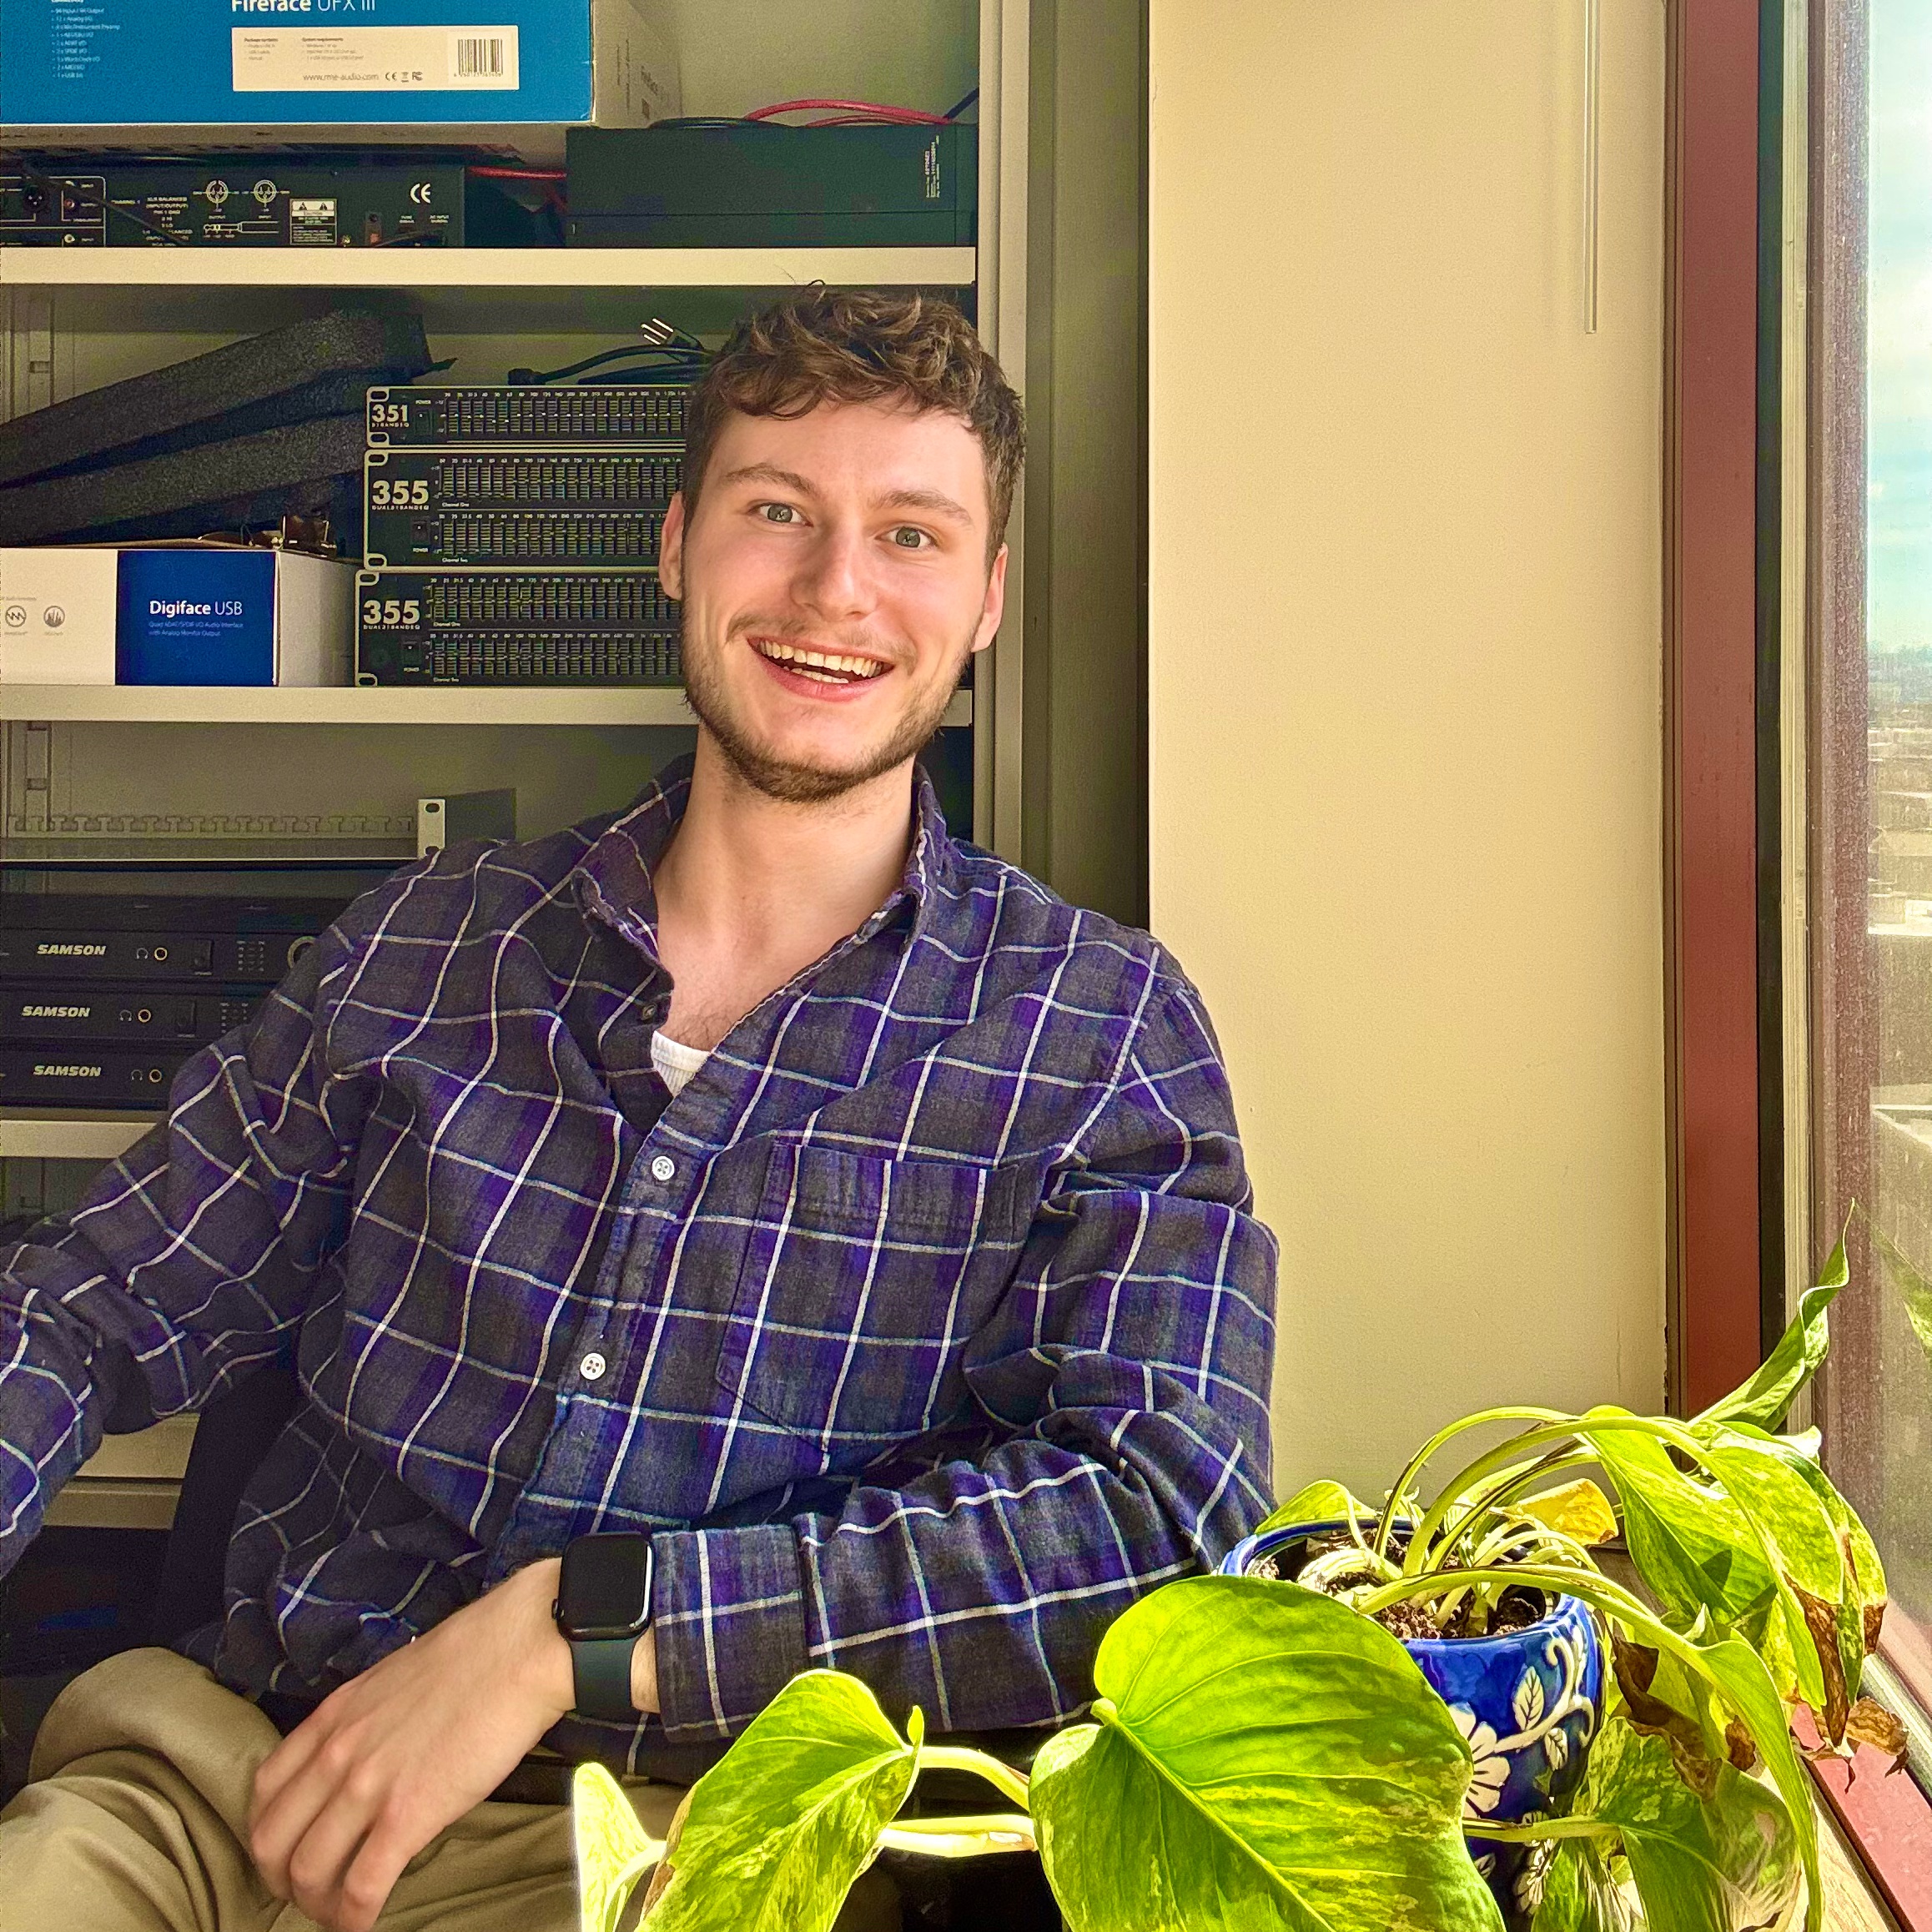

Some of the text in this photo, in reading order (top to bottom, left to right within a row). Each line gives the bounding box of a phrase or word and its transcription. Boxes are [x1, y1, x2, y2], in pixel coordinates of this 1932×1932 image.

[232, 0, 311, 12] Fireface
[372, 405, 408, 423] 351
[372, 480, 429, 505] 355
[150, 601, 243, 618] Digiface USB
[364, 600, 420, 624] 355
[37, 943, 107, 957] SAMSON
[22, 1005, 90, 1018] SAMSON
[33, 1064, 102, 1077] SAMSON
